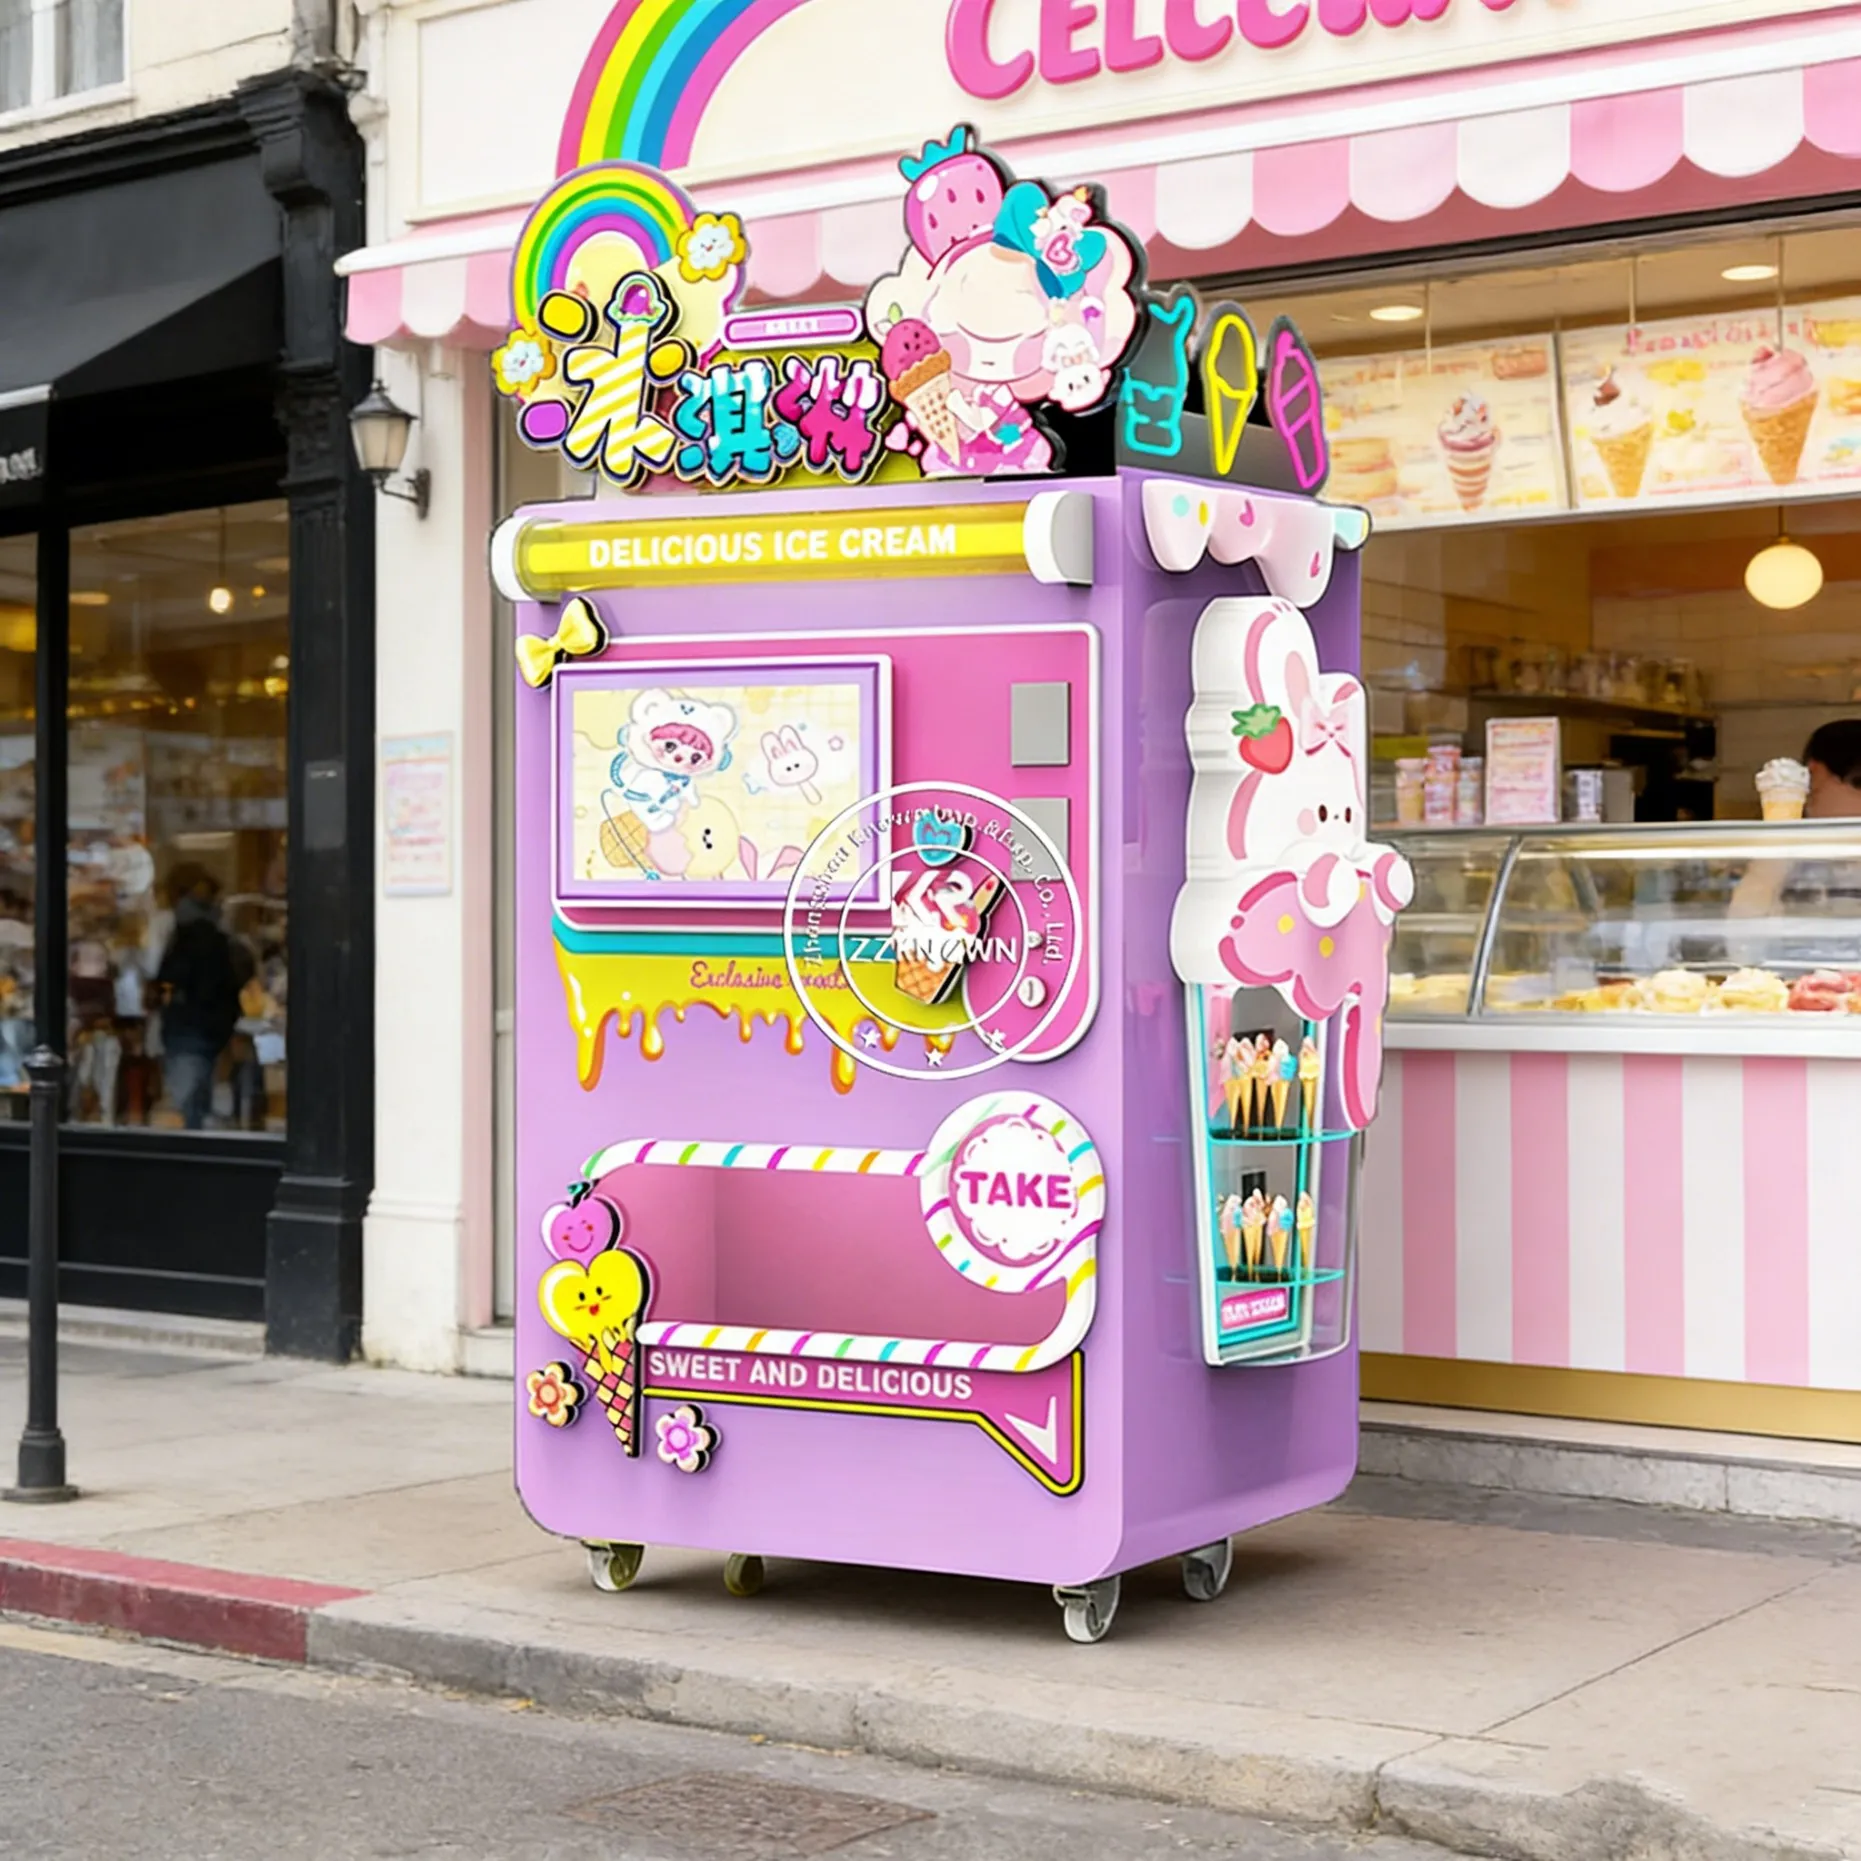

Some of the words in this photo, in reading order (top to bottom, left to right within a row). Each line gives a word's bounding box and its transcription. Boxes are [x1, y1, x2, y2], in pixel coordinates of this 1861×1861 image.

[589, 534, 762, 568] DELICIOUS
[774, 530, 828, 561] ICE
[839, 524, 956, 558] CREAM
[960, 1171, 1071, 1208] TAKE
[649, 1352, 741, 1382] SWEET
[750, 1361, 808, 1388] AND
[817, 1365, 973, 1399] DELICIOUS
